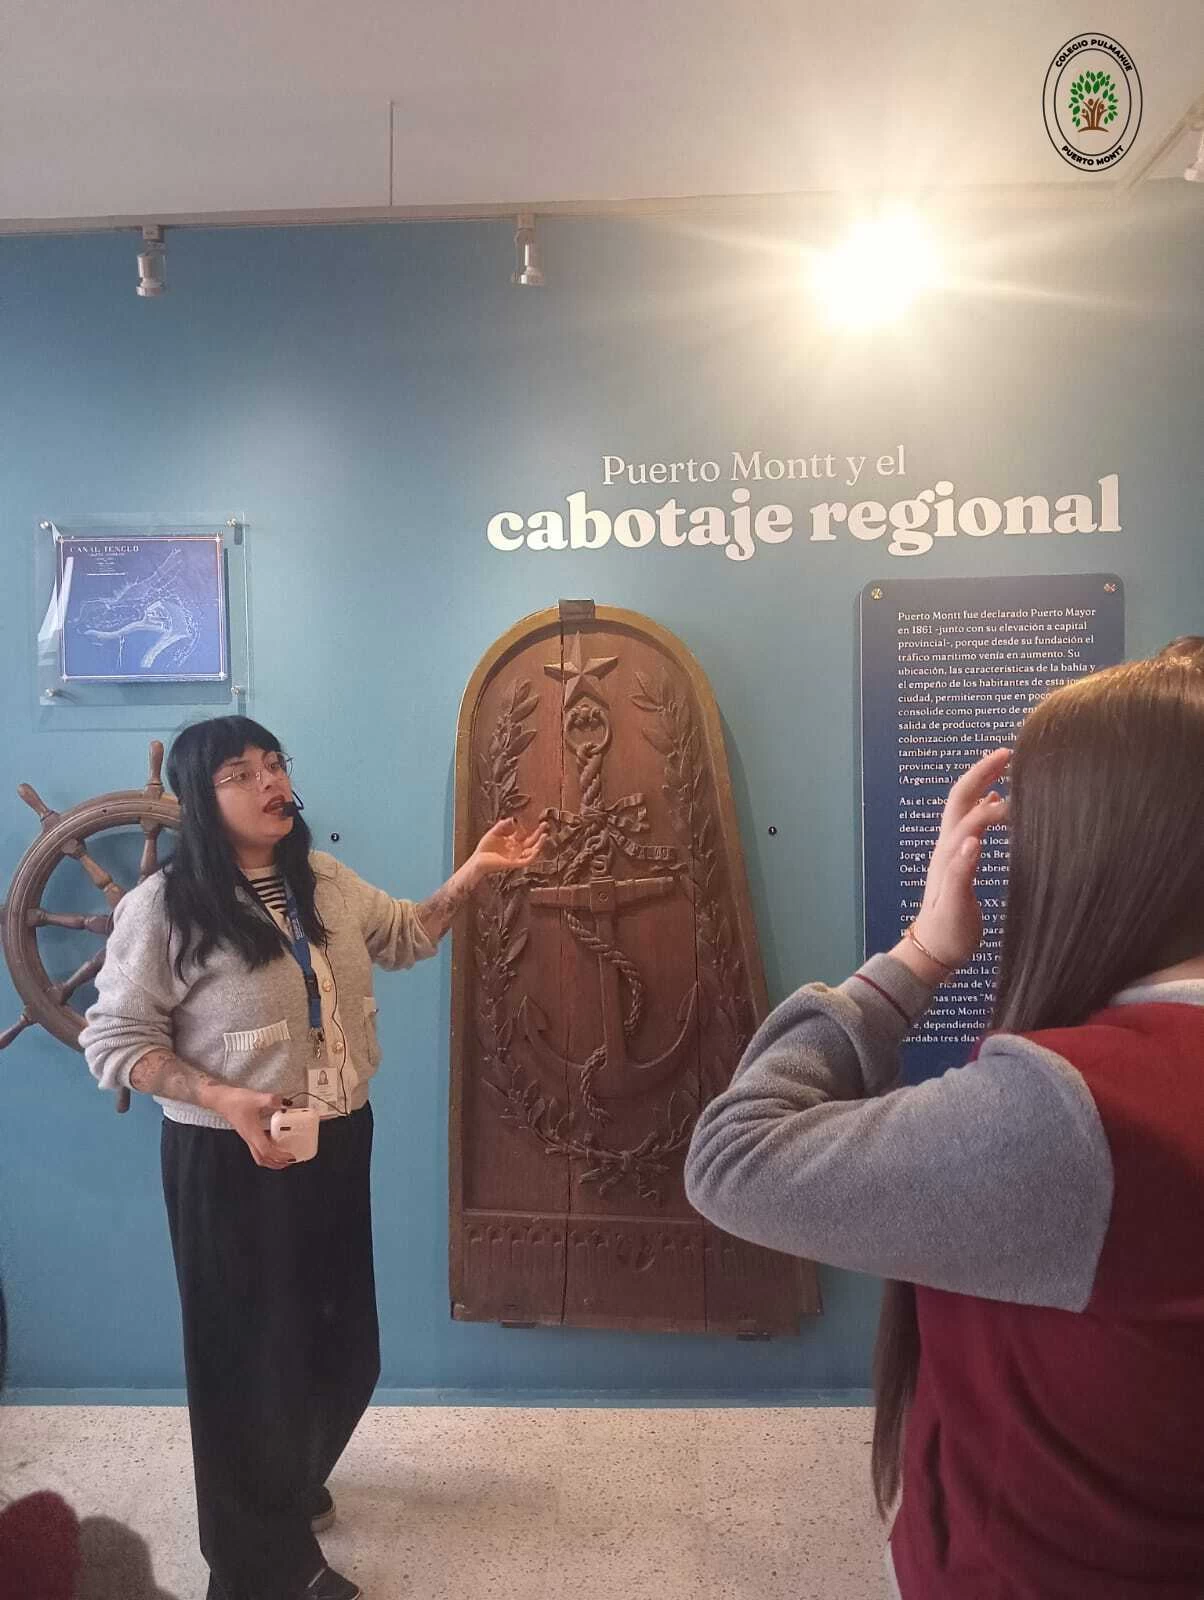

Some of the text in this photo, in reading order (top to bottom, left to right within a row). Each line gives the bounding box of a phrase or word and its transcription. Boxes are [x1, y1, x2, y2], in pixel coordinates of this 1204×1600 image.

[601, 445, 907, 487] Puerto Montt y el
[486, 474, 1123, 562] cabotaje regional
[898, 607, 1096, 621] Puerto Montt fue declarado Puerto Mayor
[897, 627, 910, 635] en
[912, 625, 933, 634] 1861
[935, 625, 965, 636] -junto
[966, 625, 984, 633] con
[999, 622, 1045, 632] elevación
[1054, 621, 1088, 632] capital
[898, 634, 1095, 650] provincial-, porque desde su fundación el
[898, 647, 1081, 662] tráfico marítimo venía en aumento. Su
[898, 661, 1097, 676] ubicación, las características de la bahía y
[897, 679, 908, 689] el
[908, 680, 948, 691] empeño
[949, 679, 961, 688] de
[963, 679, 978, 688] los
[979, 678, 1030, 688] habitantes
[1031, 677, 1043, 686] de
[1045, 677, 1065, 687] esta
[898, 693, 933, 703] ciudad,
[935, 693, 993, 704] permitieron
[994, 694, 1013, 703] que
[1014, 692, 1026, 701] en
[898, 707, 945, 717] consolide
[945, 708, 973, 716] como
[974, 706, 1007, 717] puerto
[1008, 705, 1021, 714] de
[898, 719, 927, 730] salida
[928, 720, 941, 729] de
[942, 719, 991, 731] productos
[993, 721, 1015, 731] para
[898, 731, 1017, 744] colonización de Llanquih
[898, 747, 939, 757] también
[940, 748, 962, 759] para
[899, 761, 945, 773] provincia
[945, 762, 952, 772] y
[900, 796, 949, 806] Así el cabo
[899, 810, 908, 819] el
[899, 823, 1007, 833] destacan ción
[899, 839, 935, 848] empres
[990, 836, 1009, 845] loca
[900, 850, 926, 861] Jorge
[993, 849, 1010, 859] Bra
[900, 864, 928, 873] Oelck
[900, 878, 927, 887] rumb
[972, 876, 1000, 887] dición
[900, 899, 907, 908] A
[983, 898, 999, 908] XX
[979, 940, 1001, 949] Punt
[971, 952, 993, 962] 1913
[951, 965, 979, 975] ando
[980, 965, 990, 975] la
[939, 980, 969, 989] ricana
[970, 979, 983, 989] de
[923, 1020, 985, 1031] dependiendo
[940, 1033, 959, 1042] tres
